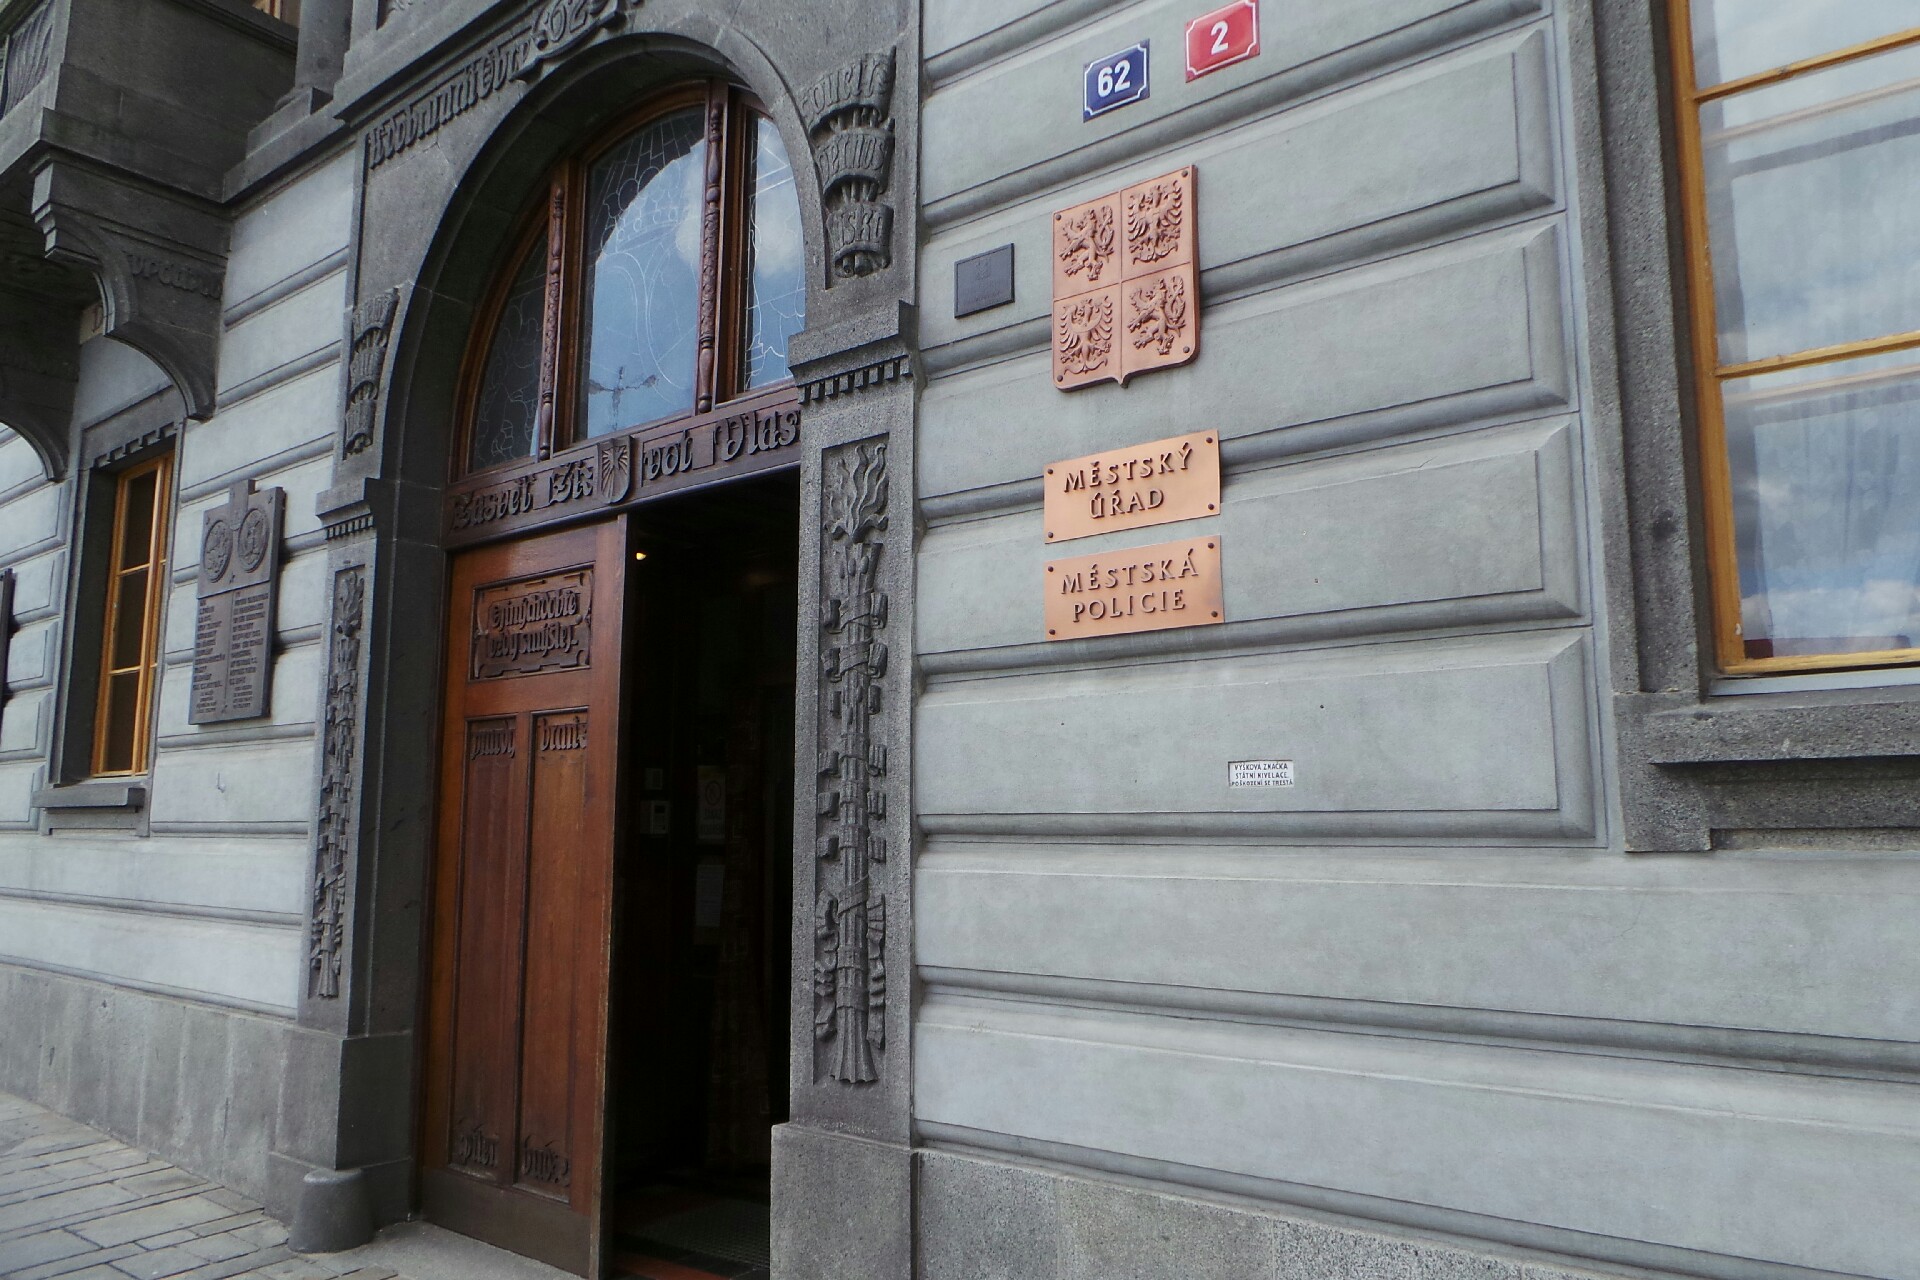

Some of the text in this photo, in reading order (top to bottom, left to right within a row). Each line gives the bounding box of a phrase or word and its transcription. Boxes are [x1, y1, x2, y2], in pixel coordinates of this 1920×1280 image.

[1210, 20, 1229, 55] 2
[1097, 59, 1131, 97] 62
[1063, 442, 1193, 493] MĚSTSKÝ
[1089, 488, 1165, 519] ÚŘAD
[1072, 589, 1186, 622] POLICIE
